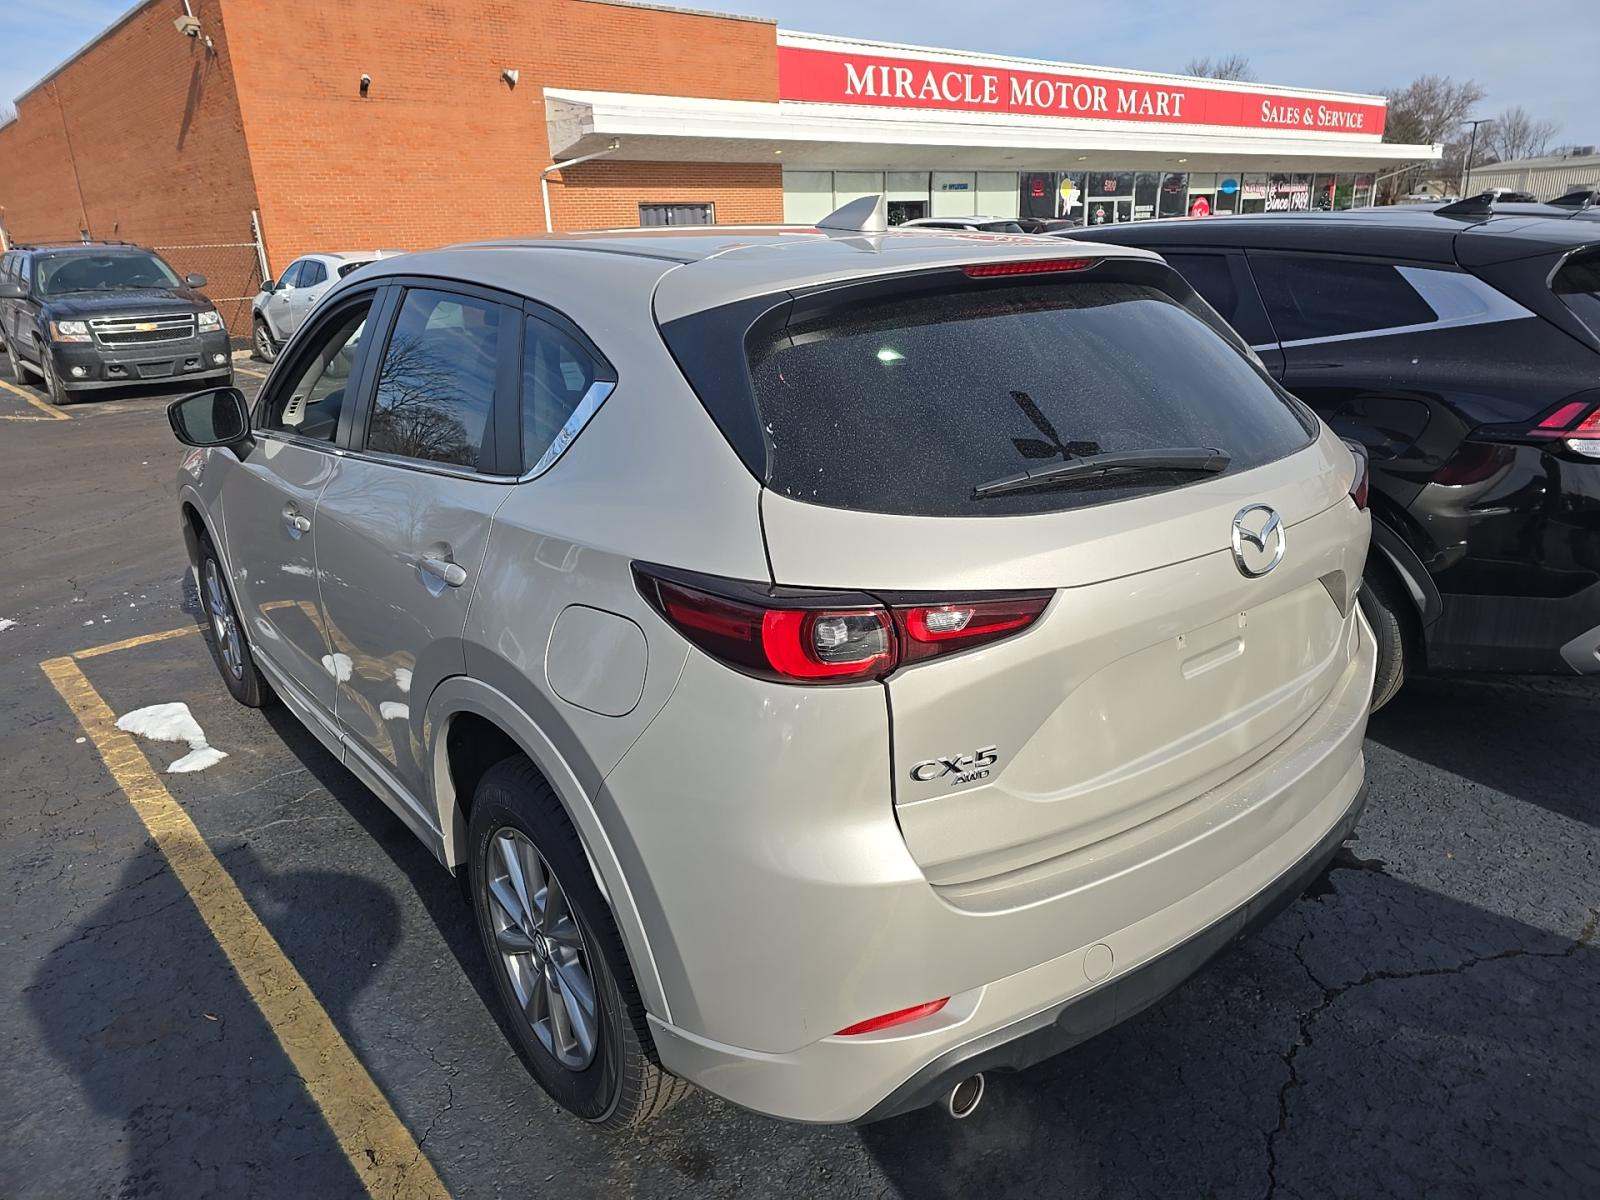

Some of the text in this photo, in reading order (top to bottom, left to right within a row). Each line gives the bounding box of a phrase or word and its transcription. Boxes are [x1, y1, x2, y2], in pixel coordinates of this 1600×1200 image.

[844, 63, 1184, 117] MIRACLE MOTOR MART
[1261, 99, 1364, 129] SALES & SERVICE
[1266, 191, 1288, 210] Since
[909, 744, 998, 782] CX-5
[951, 769, 990, 786] AWD
